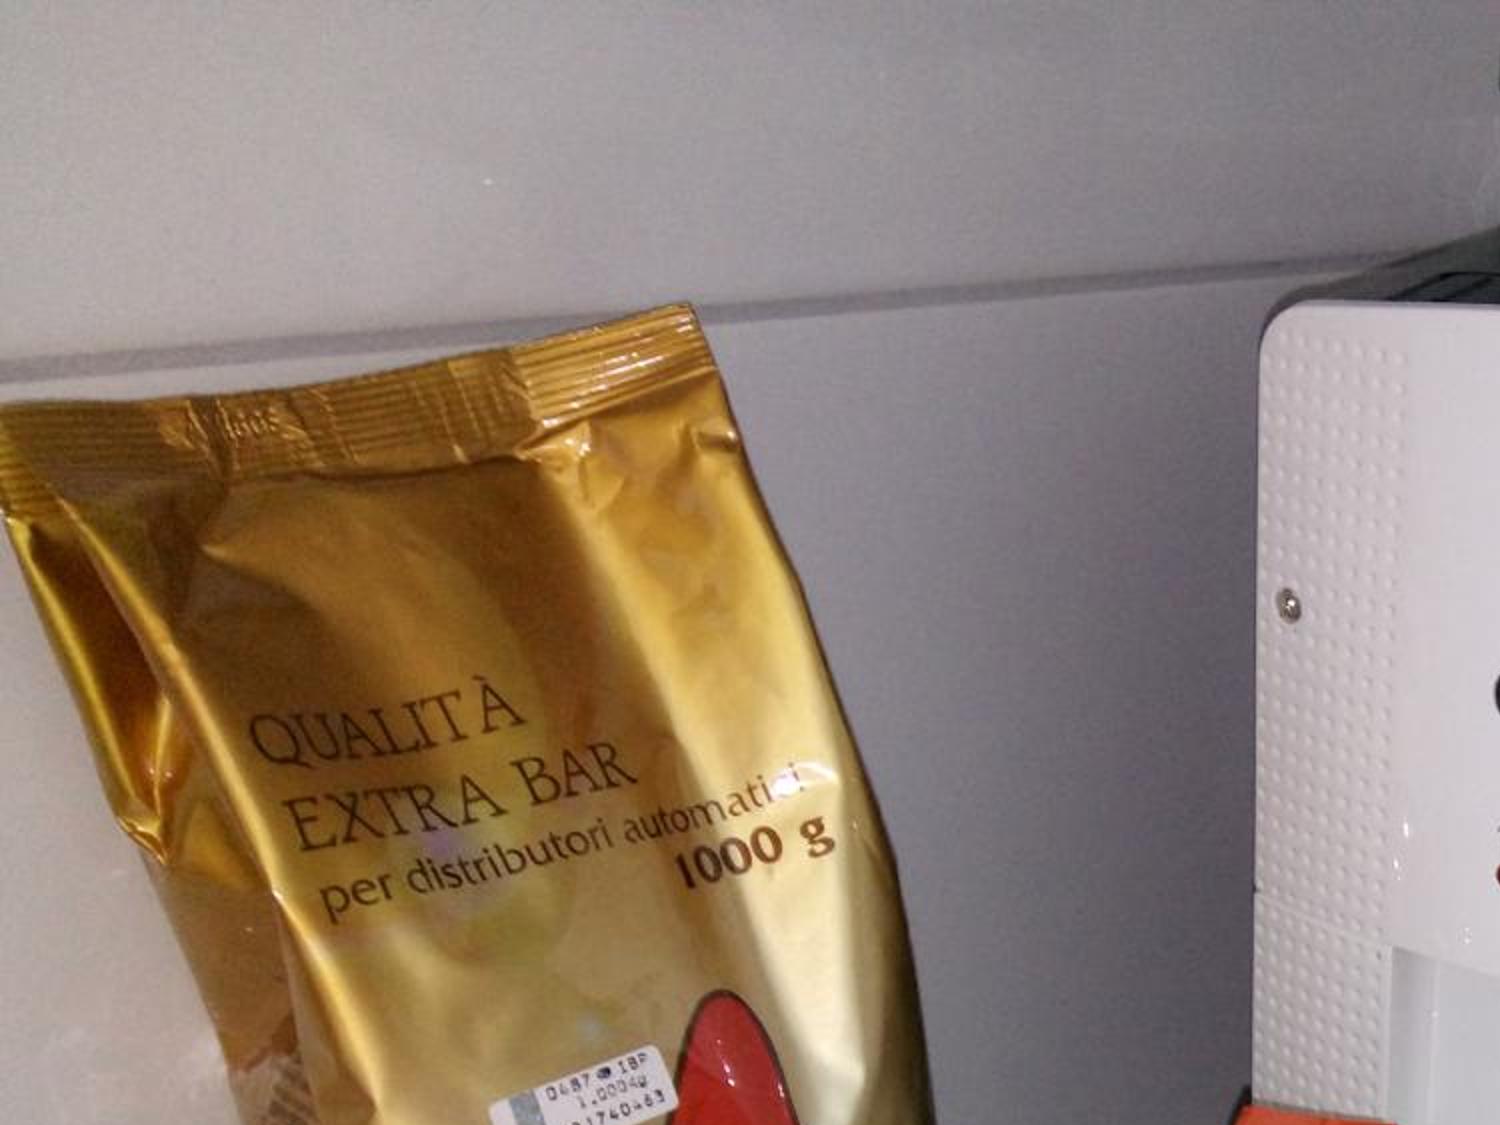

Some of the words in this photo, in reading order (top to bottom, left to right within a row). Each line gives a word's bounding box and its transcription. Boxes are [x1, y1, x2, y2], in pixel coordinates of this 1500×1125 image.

[249, 676, 528, 768] QUALITÀ
[283, 774, 508, 853] EXTRA
[510, 742, 637, 806] BAR
[318, 876, 396, 924] per
[404, 820, 616, 896] distributori
[622, 762, 806, 846] automatii
[675, 825, 784, 890] 1000
[799, 815, 836, 859] g
